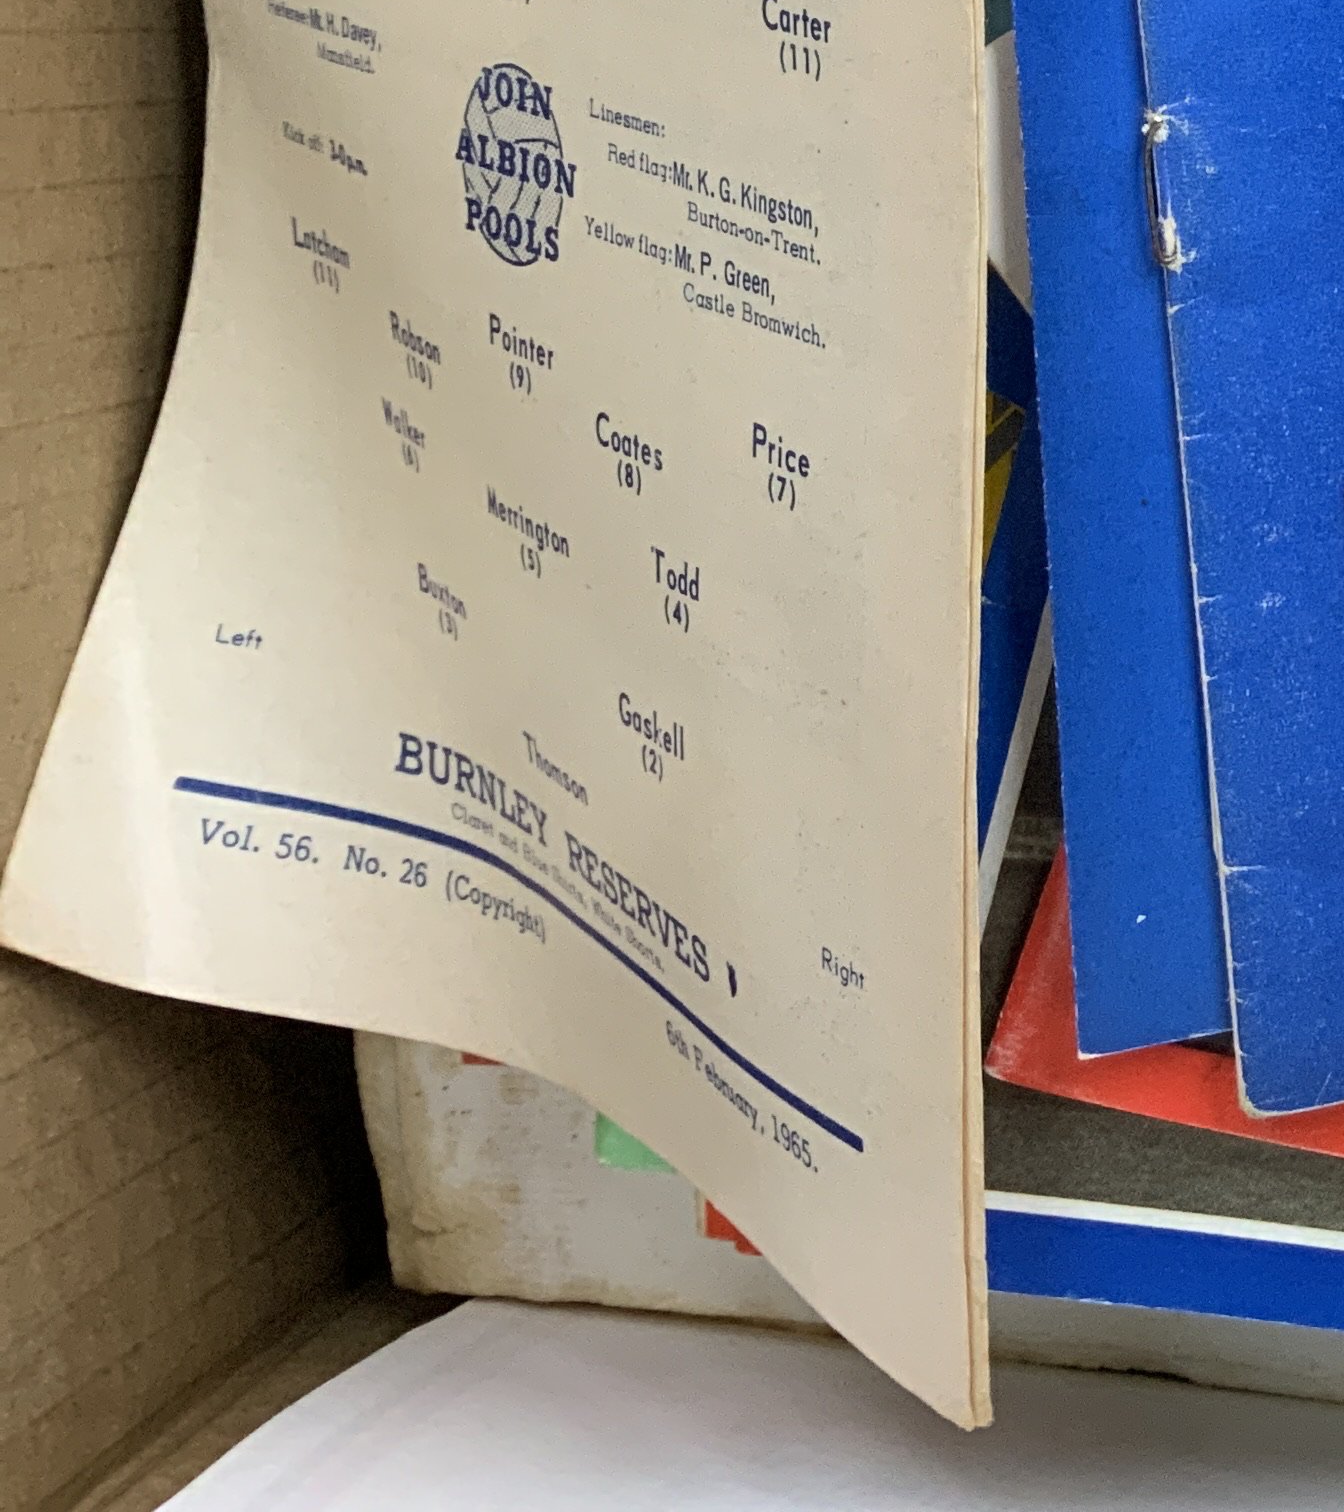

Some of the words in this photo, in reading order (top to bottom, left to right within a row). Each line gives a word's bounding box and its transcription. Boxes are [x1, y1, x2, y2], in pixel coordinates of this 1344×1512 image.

[780, 41, 822, 81] (11)
[478, 67, 552, 120] JOIN
[589, 98, 665, 138] Linesmen:
[456, 128, 577, 198] ALBION
[608, 143, 635, 169] Red
[639, 151, 672, 182] flag:
[673, 161, 692, 191] Mr.
[697, 169, 714, 198] K.
[720, 177, 736, 204] G.
[741, 182, 819, 237] Kingston,
[465, 197, 559, 262] POOLS
[585, 215, 634, 249] Yellow
[639, 234, 672, 265] flag:
[675, 244, 695, 274] Mr.
[701, 251, 717, 280] P.
[725, 260, 775, 305] Green,
[688, 201, 821, 265] Burton-on-Trent.
[489, 312, 554, 372] Pointer
[683, 282, 735, 317] Castle
[742, 301, 826, 348] Bromwich.
[596, 411, 664, 472] Coates
[752, 423, 810, 477] Price
[617, 458, 641, 495] (8)
[768, 474, 796, 510] (7)
[487, 484, 570, 558] Merrington
[651, 546, 699, 601] Todd
[214, 622, 262, 650] Left
[665, 594, 690, 633] (4)
[619, 692, 684, 761] Gaskell
[522, 730, 588, 806] Thomson
[201, 818, 260, 855] Vol.
[275, 833, 320, 865] 56.
[343, 847, 387, 878] No.
[399, 862, 428, 888] 26
[444, 870, 547, 943] (Copyright)
[394, 733, 548, 847] BURNLEY
[564, 830, 709, 982] RESERVES
[822, 946, 864, 989] Right
[666, 1020, 689, 1060] 6th
[771, 1114, 818, 1173] 1965.
